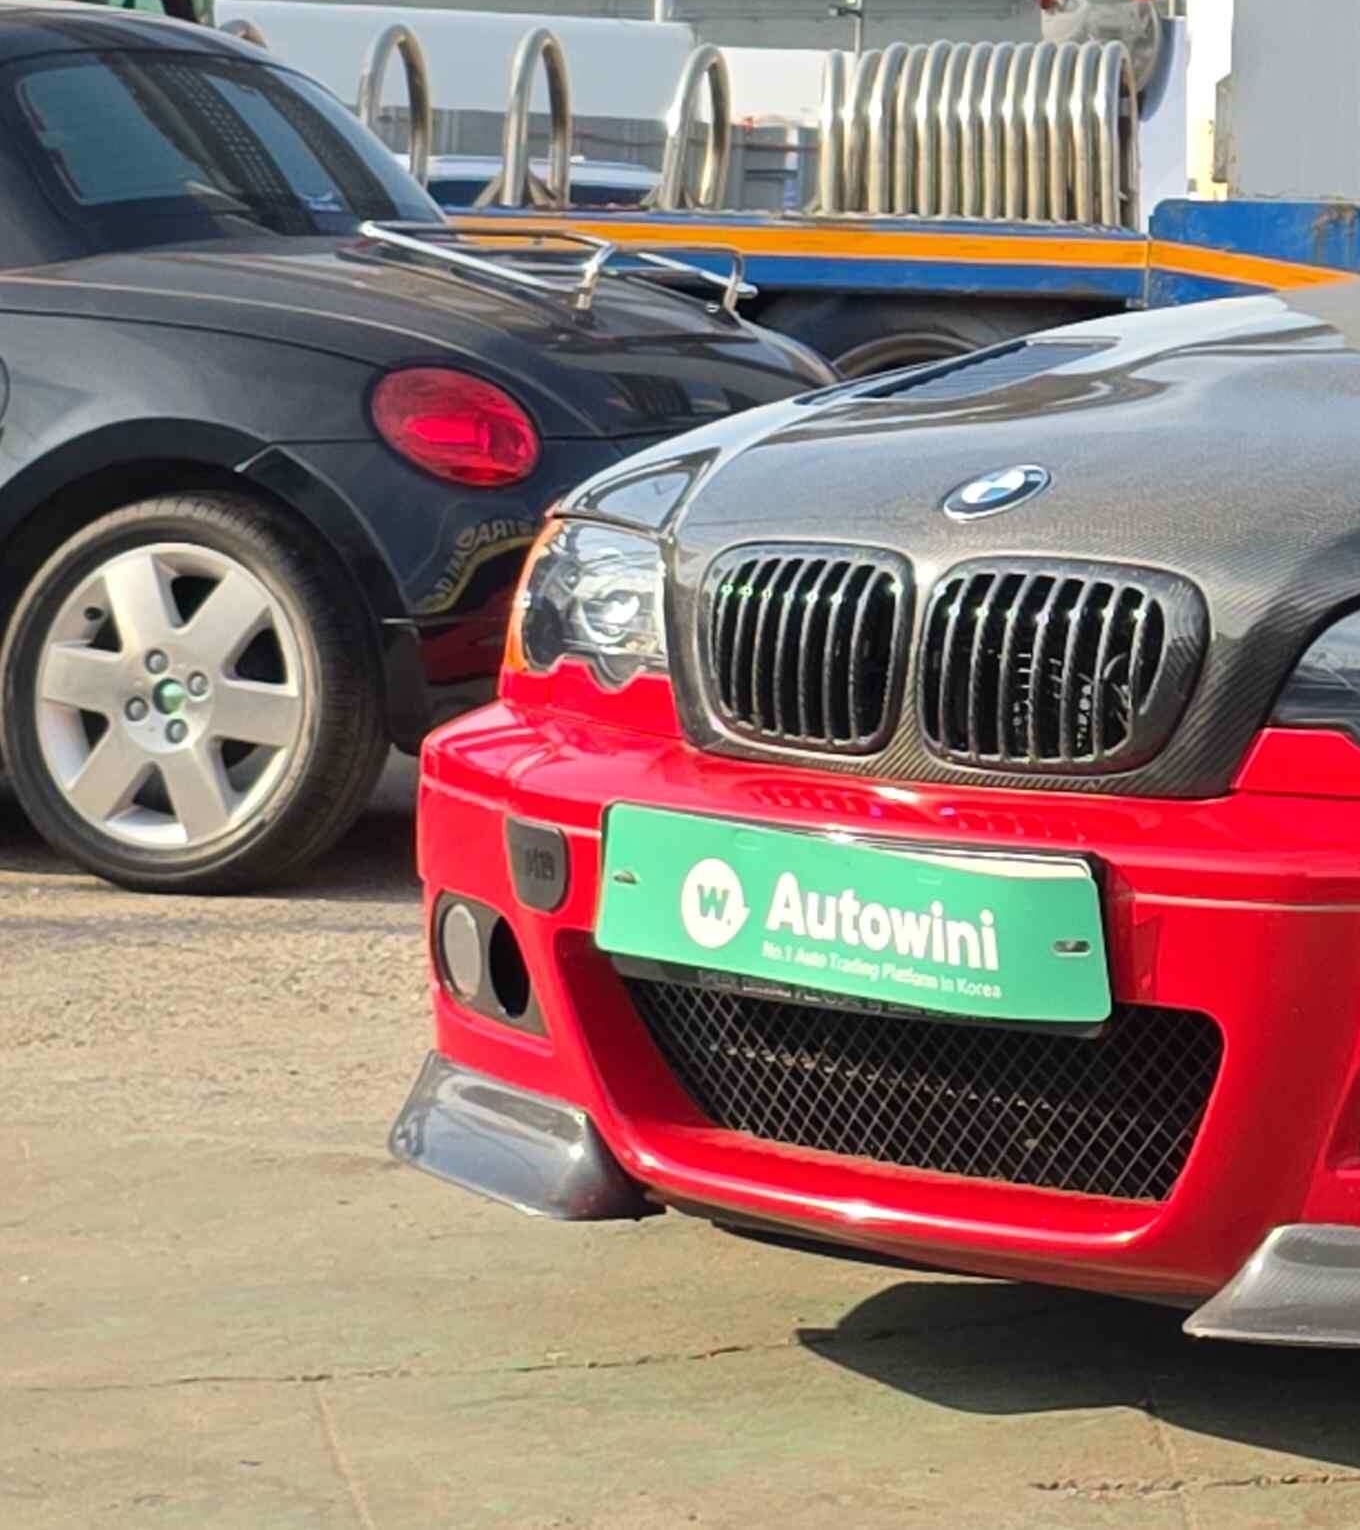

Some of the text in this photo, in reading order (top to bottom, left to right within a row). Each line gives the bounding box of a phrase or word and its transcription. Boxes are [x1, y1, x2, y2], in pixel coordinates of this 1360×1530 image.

[764, 870, 999, 971] Autowini
[829, 951, 880, 982] Trading
[955, 977, 1003, 999] Korea
